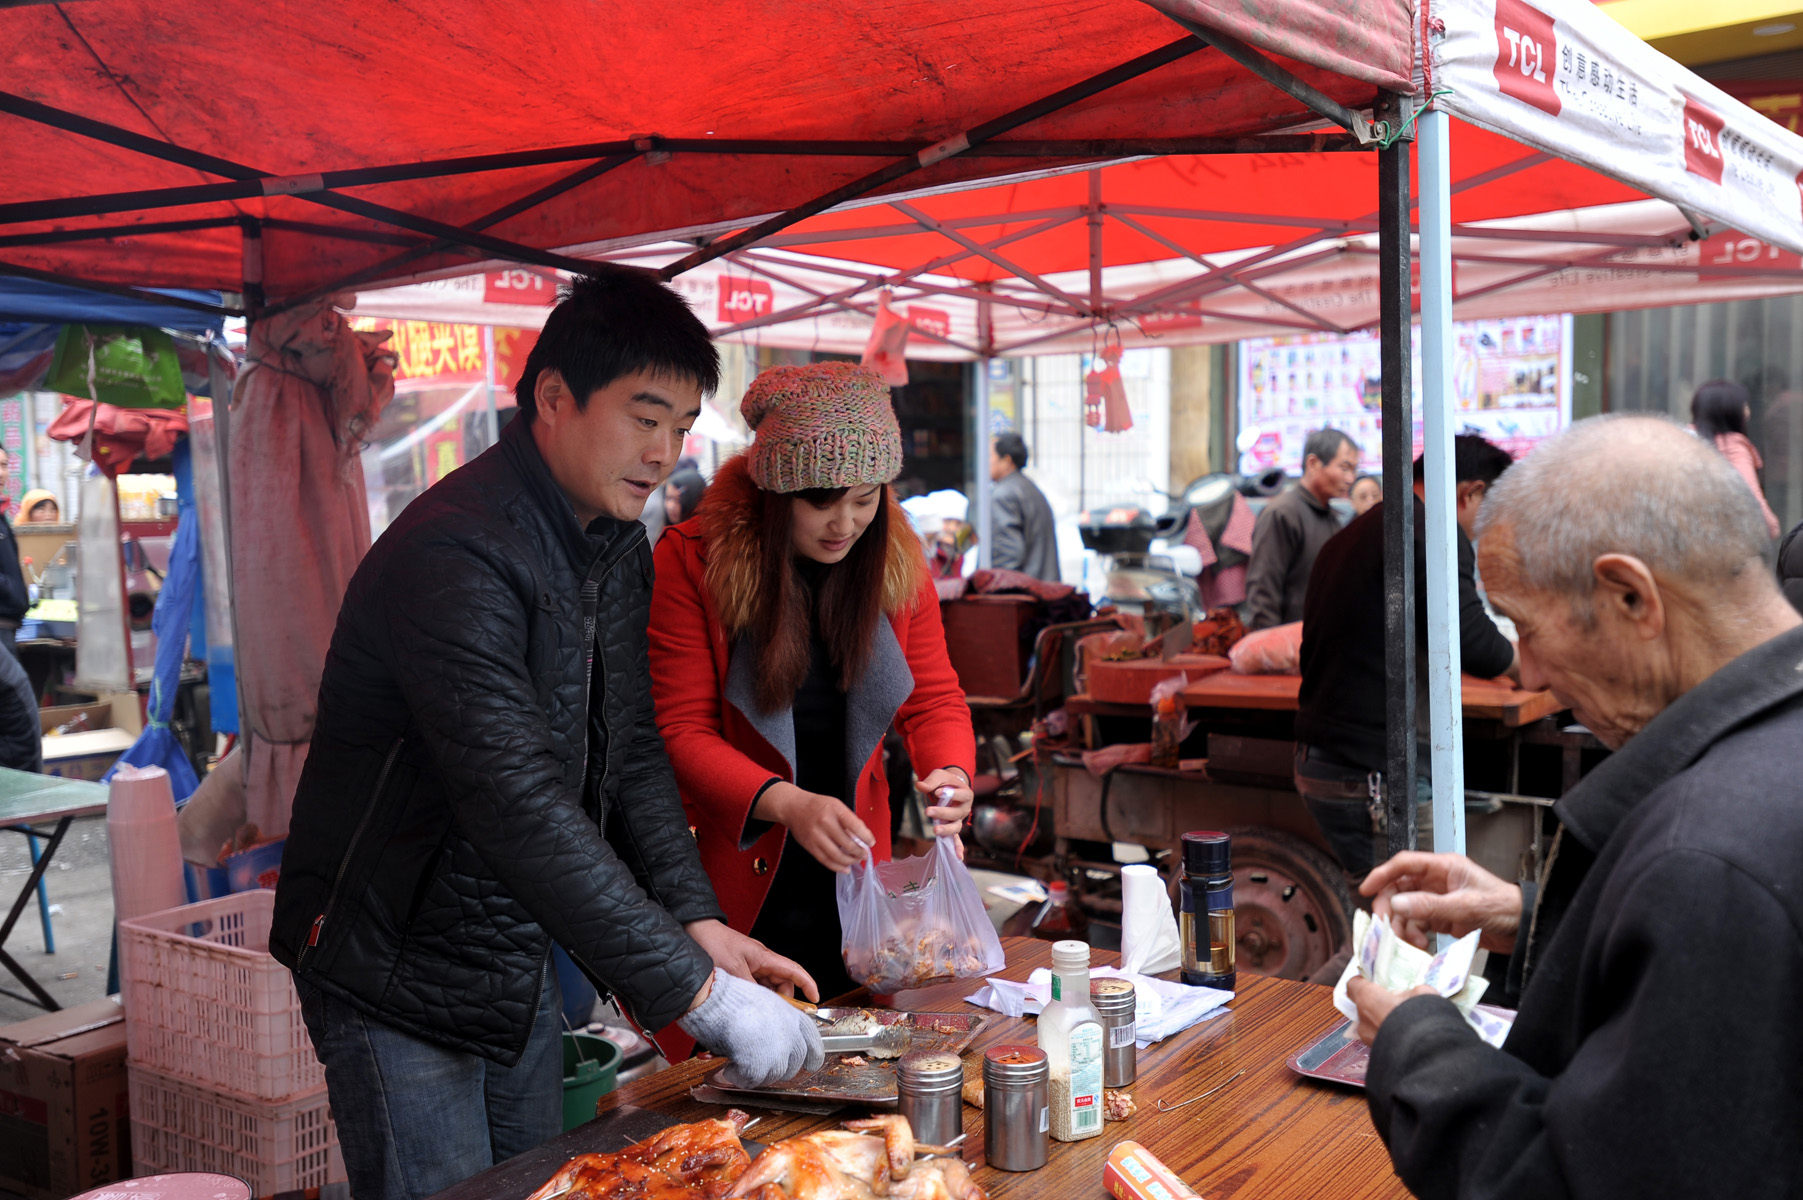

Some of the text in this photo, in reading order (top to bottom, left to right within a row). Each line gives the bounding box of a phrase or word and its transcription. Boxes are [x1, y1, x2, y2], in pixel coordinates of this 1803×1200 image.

[1503, 25, 1546, 84] TCL
[1562, 44, 1638, 107] 创意感动生活
[1687, 118, 1720, 159] TCL
